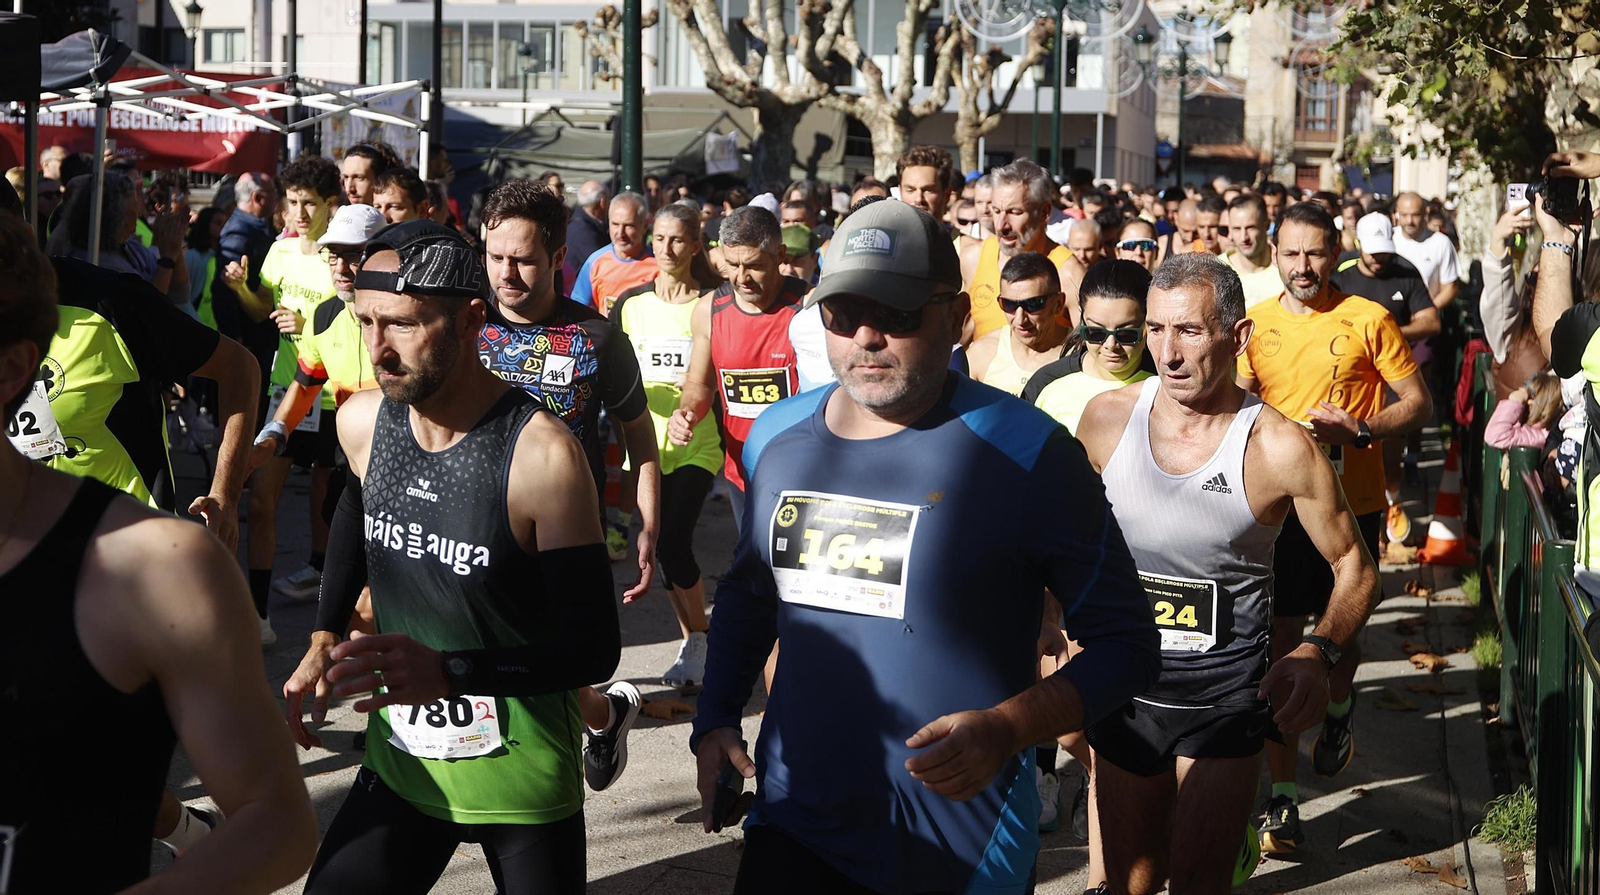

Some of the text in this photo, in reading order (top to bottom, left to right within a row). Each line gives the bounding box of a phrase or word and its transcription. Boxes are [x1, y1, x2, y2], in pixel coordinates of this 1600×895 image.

[66, 107, 109, 128] POL
[848, 234, 875, 246] NORTH
[860, 228, 876, 236] THE
[853, 240, 874, 250] FACE
[399, 242, 482, 291] NIKE
[651, 352, 684, 367] 531
[540, 384, 570, 393] fundación
[739, 384, 780, 403] 163
[406, 486, 438, 502] amura
[1202, 483, 1232, 495] adidas
[364, 511, 490, 576] máis que auga
[798, 528, 884, 575] 164
[1142, 575, 1154, 583] POLA
[1155, 577, 1184, 587] ESCLEROSE
[1154, 600, 1198, 628] 24
[408, 697, 473, 728] 780
